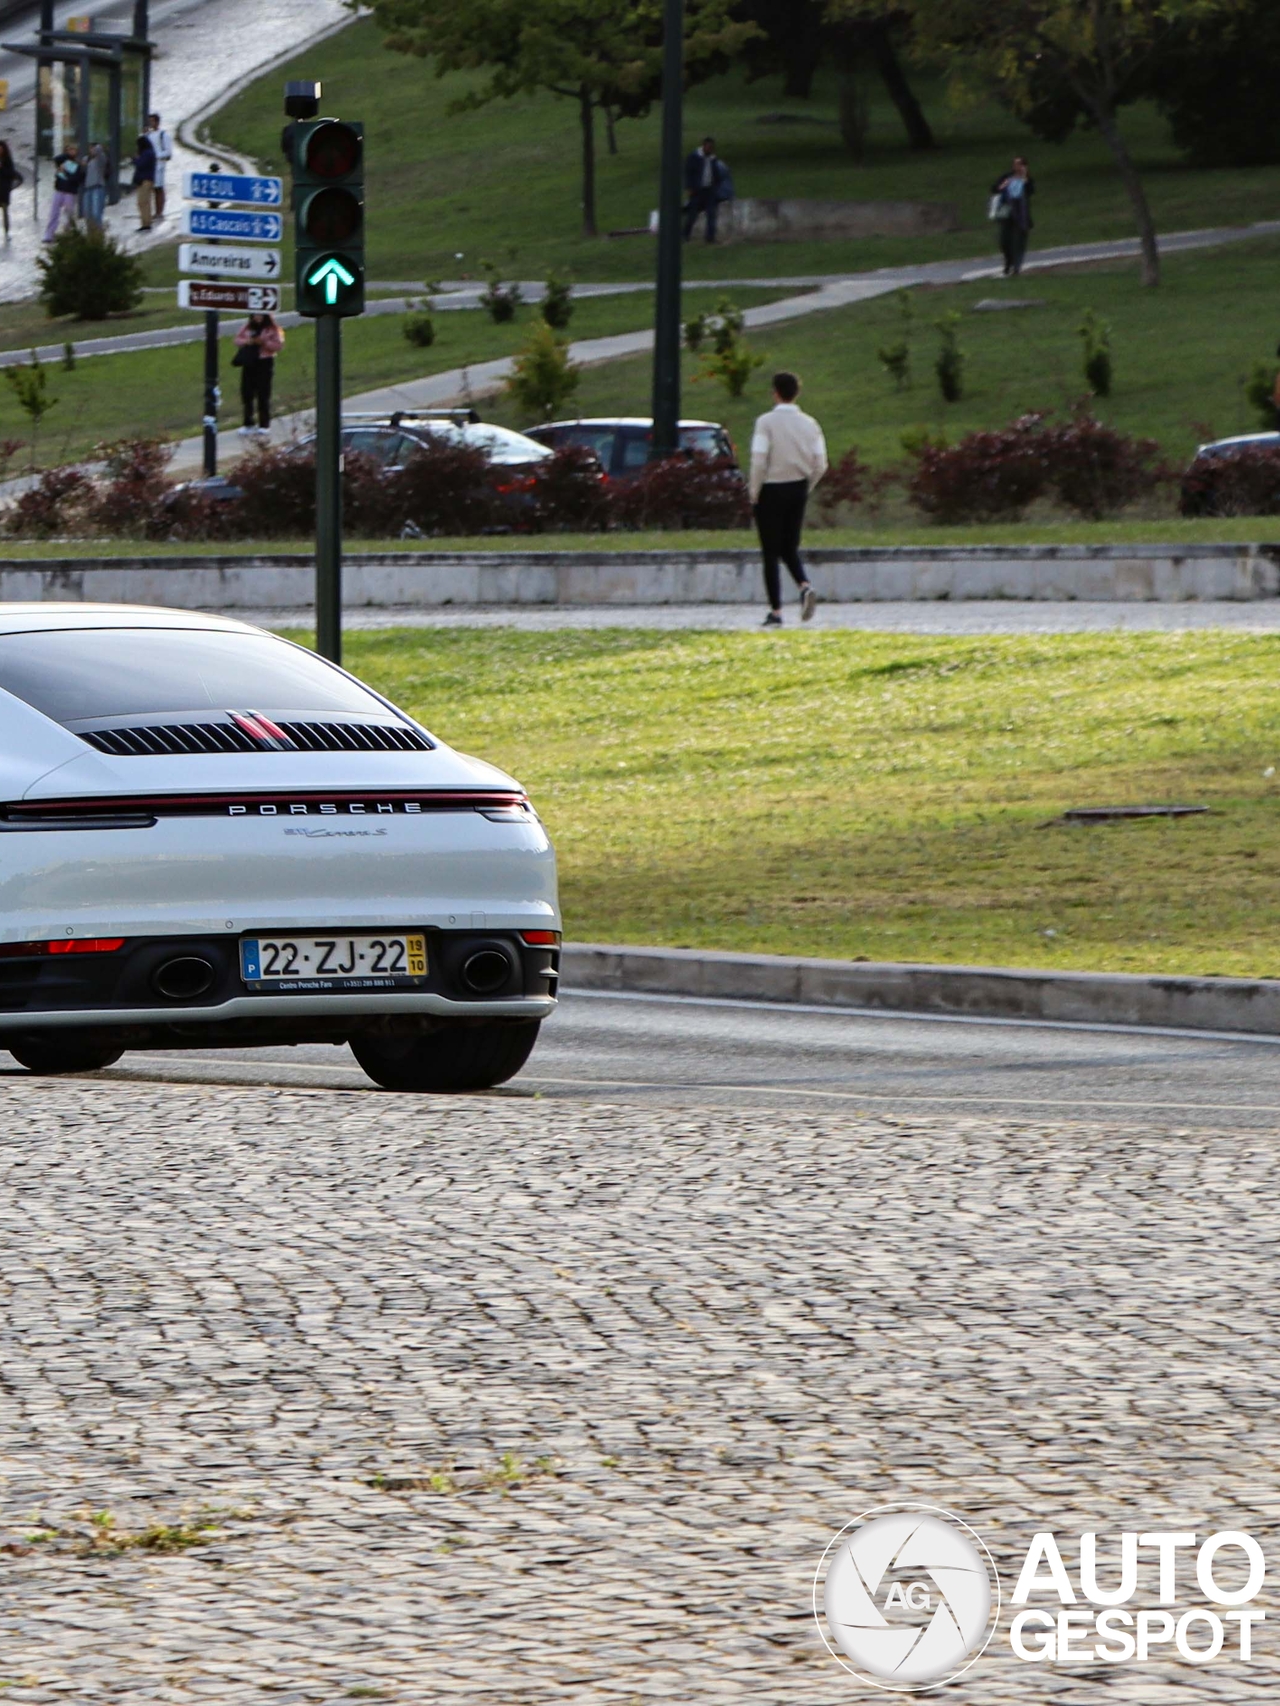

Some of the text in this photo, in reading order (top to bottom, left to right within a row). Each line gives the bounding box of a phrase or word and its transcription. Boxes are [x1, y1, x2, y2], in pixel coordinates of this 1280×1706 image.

[208, 215, 251, 233] Cascais
[191, 252, 251, 269] Amoreiras
[228, 803, 423, 816] PORSCHE
[409, 939, 423, 951] 19
[247, 964, 256, 974] P
[410, 959, 424, 972] 10
[298, 981, 320, 989] Porsche
